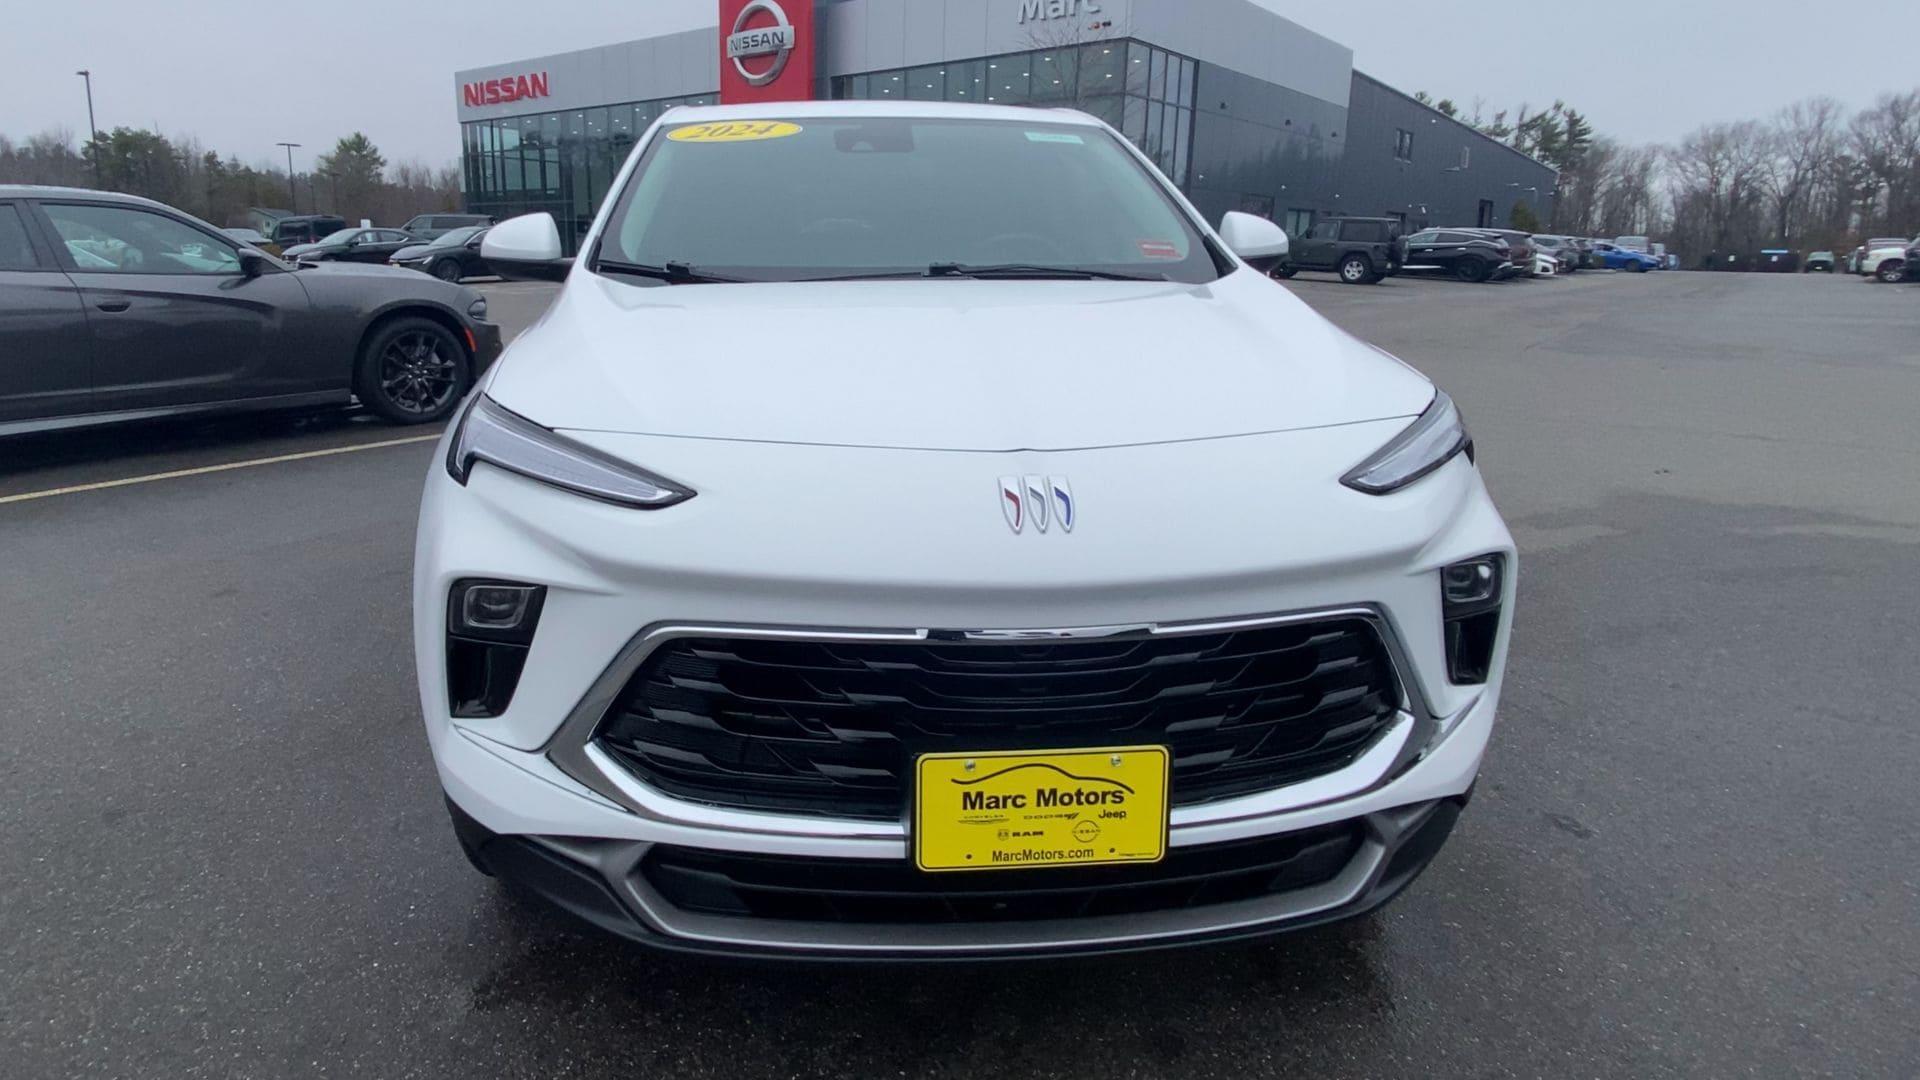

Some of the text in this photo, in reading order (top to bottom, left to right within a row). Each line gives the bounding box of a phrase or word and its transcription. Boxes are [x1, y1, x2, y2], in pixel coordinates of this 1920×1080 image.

[1018, 0, 1101, 24] Marc
[730, 31, 784, 51] NISSAN
[463, 71, 548, 107] NISSAN
[683, 123, 778, 138] 2024
[962, 787, 1124, 810] Marc Motors
[1098, 809, 1127, 819] Jeep
[992, 848, 1094, 862] MarcMotors.com
